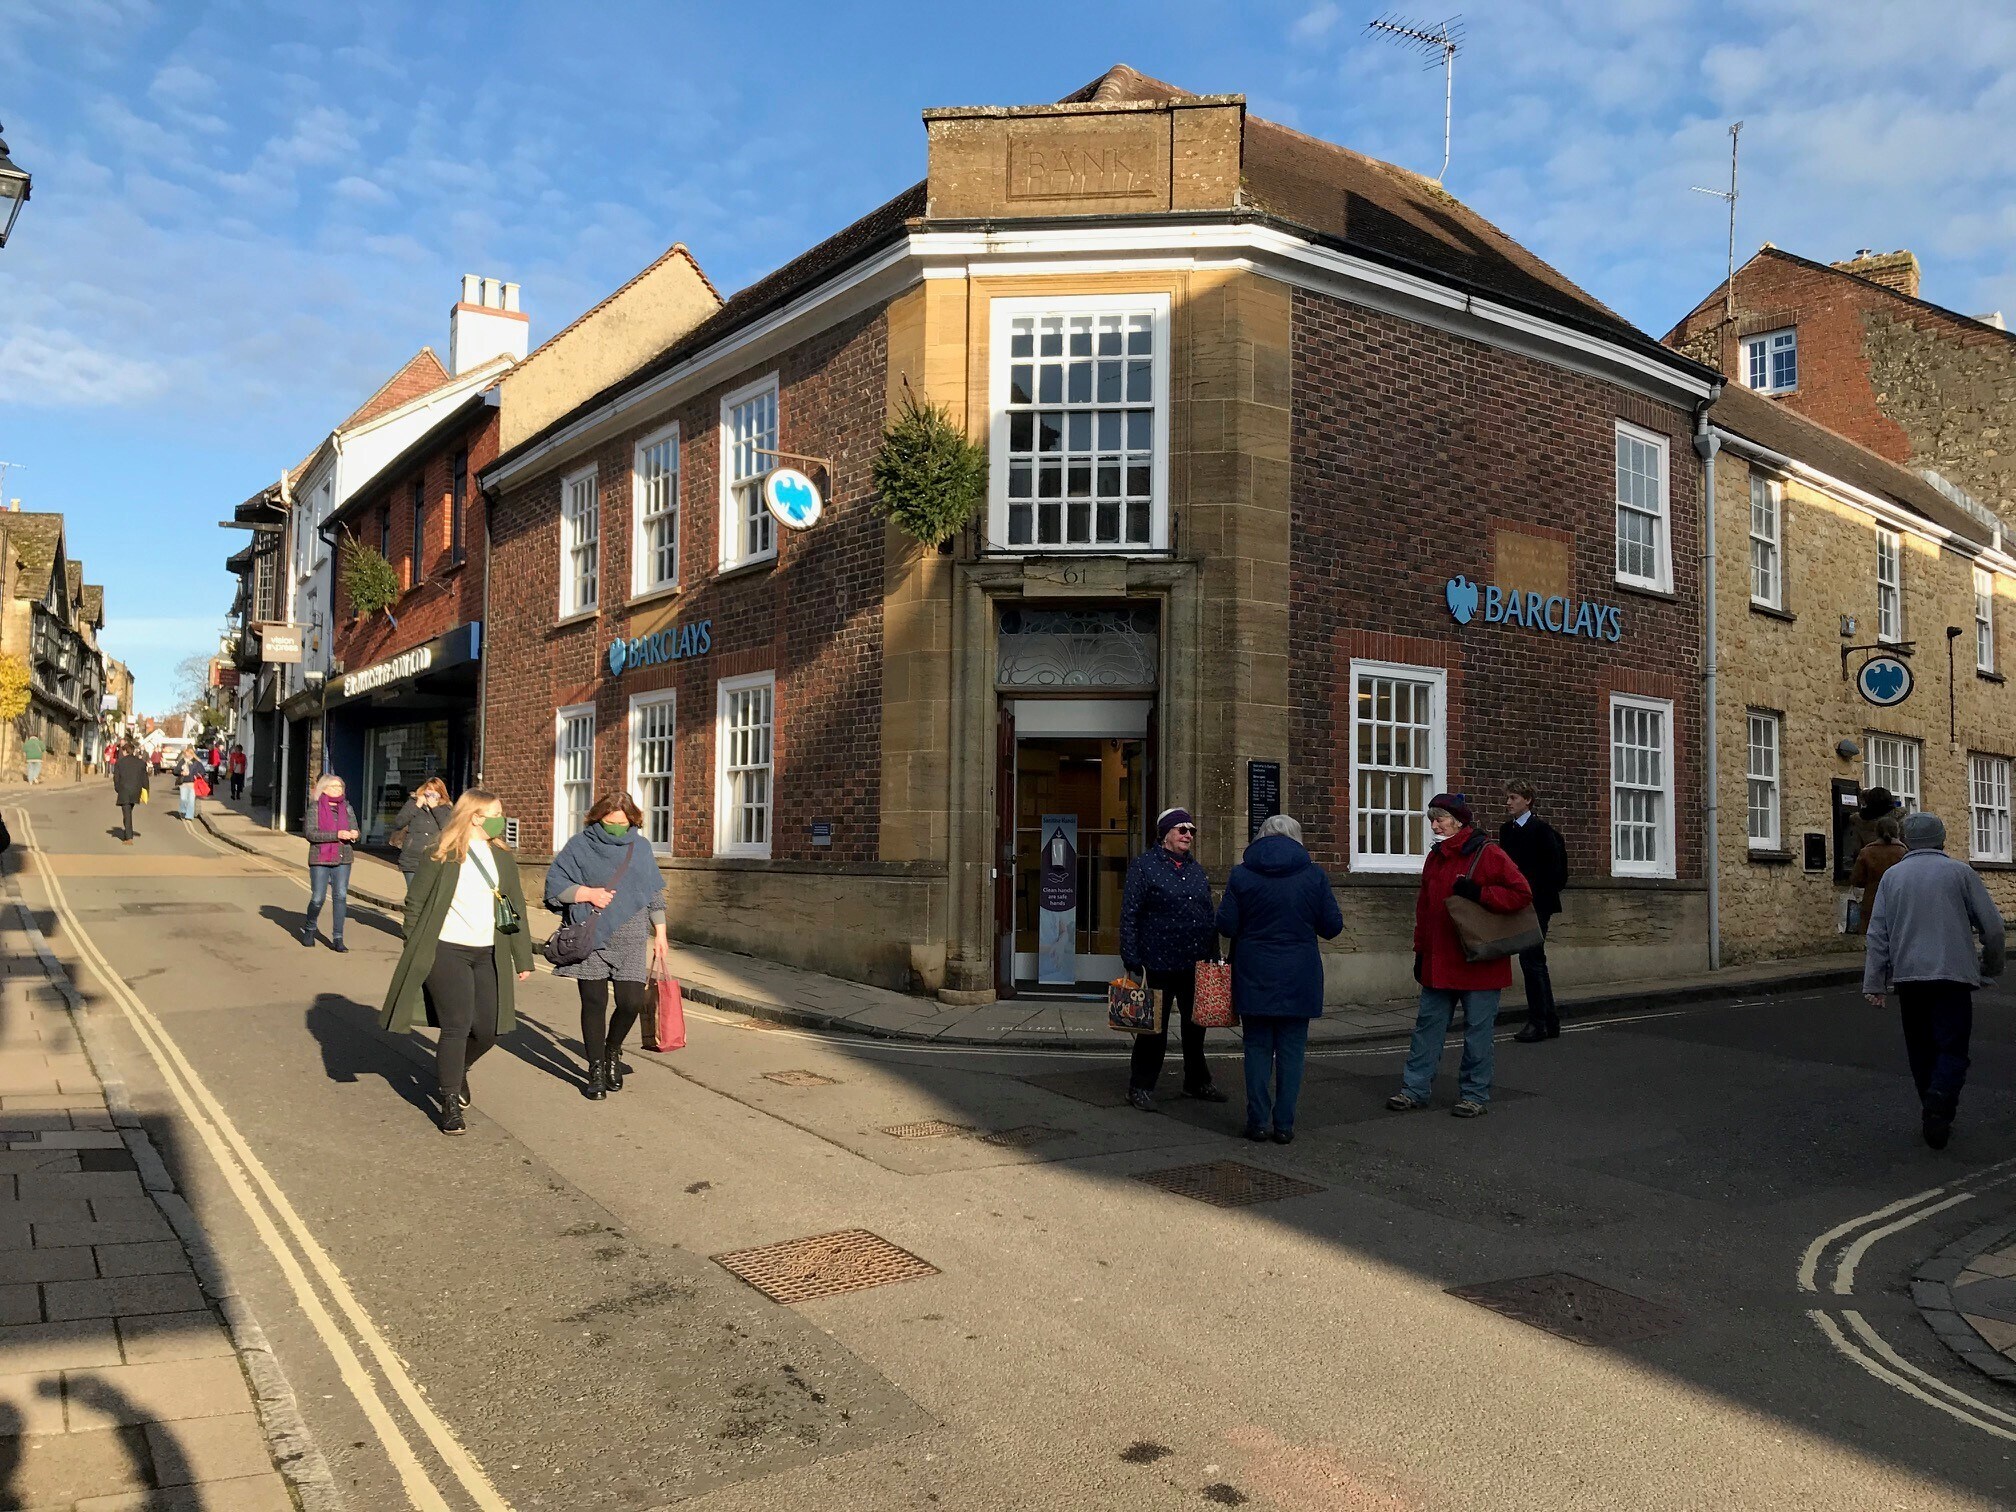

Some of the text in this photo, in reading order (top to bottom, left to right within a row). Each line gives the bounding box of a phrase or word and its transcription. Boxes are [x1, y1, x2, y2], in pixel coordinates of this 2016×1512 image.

[1028, 149, 1133, 178] BANK
[1064, 565, 1086, 583] 61
[1485, 586, 1621, 642] BARCLAYS
[266, 643, 299, 652] express
[271, 636, 294, 645] vision
[629, 620, 712, 669] BARCLAYS
